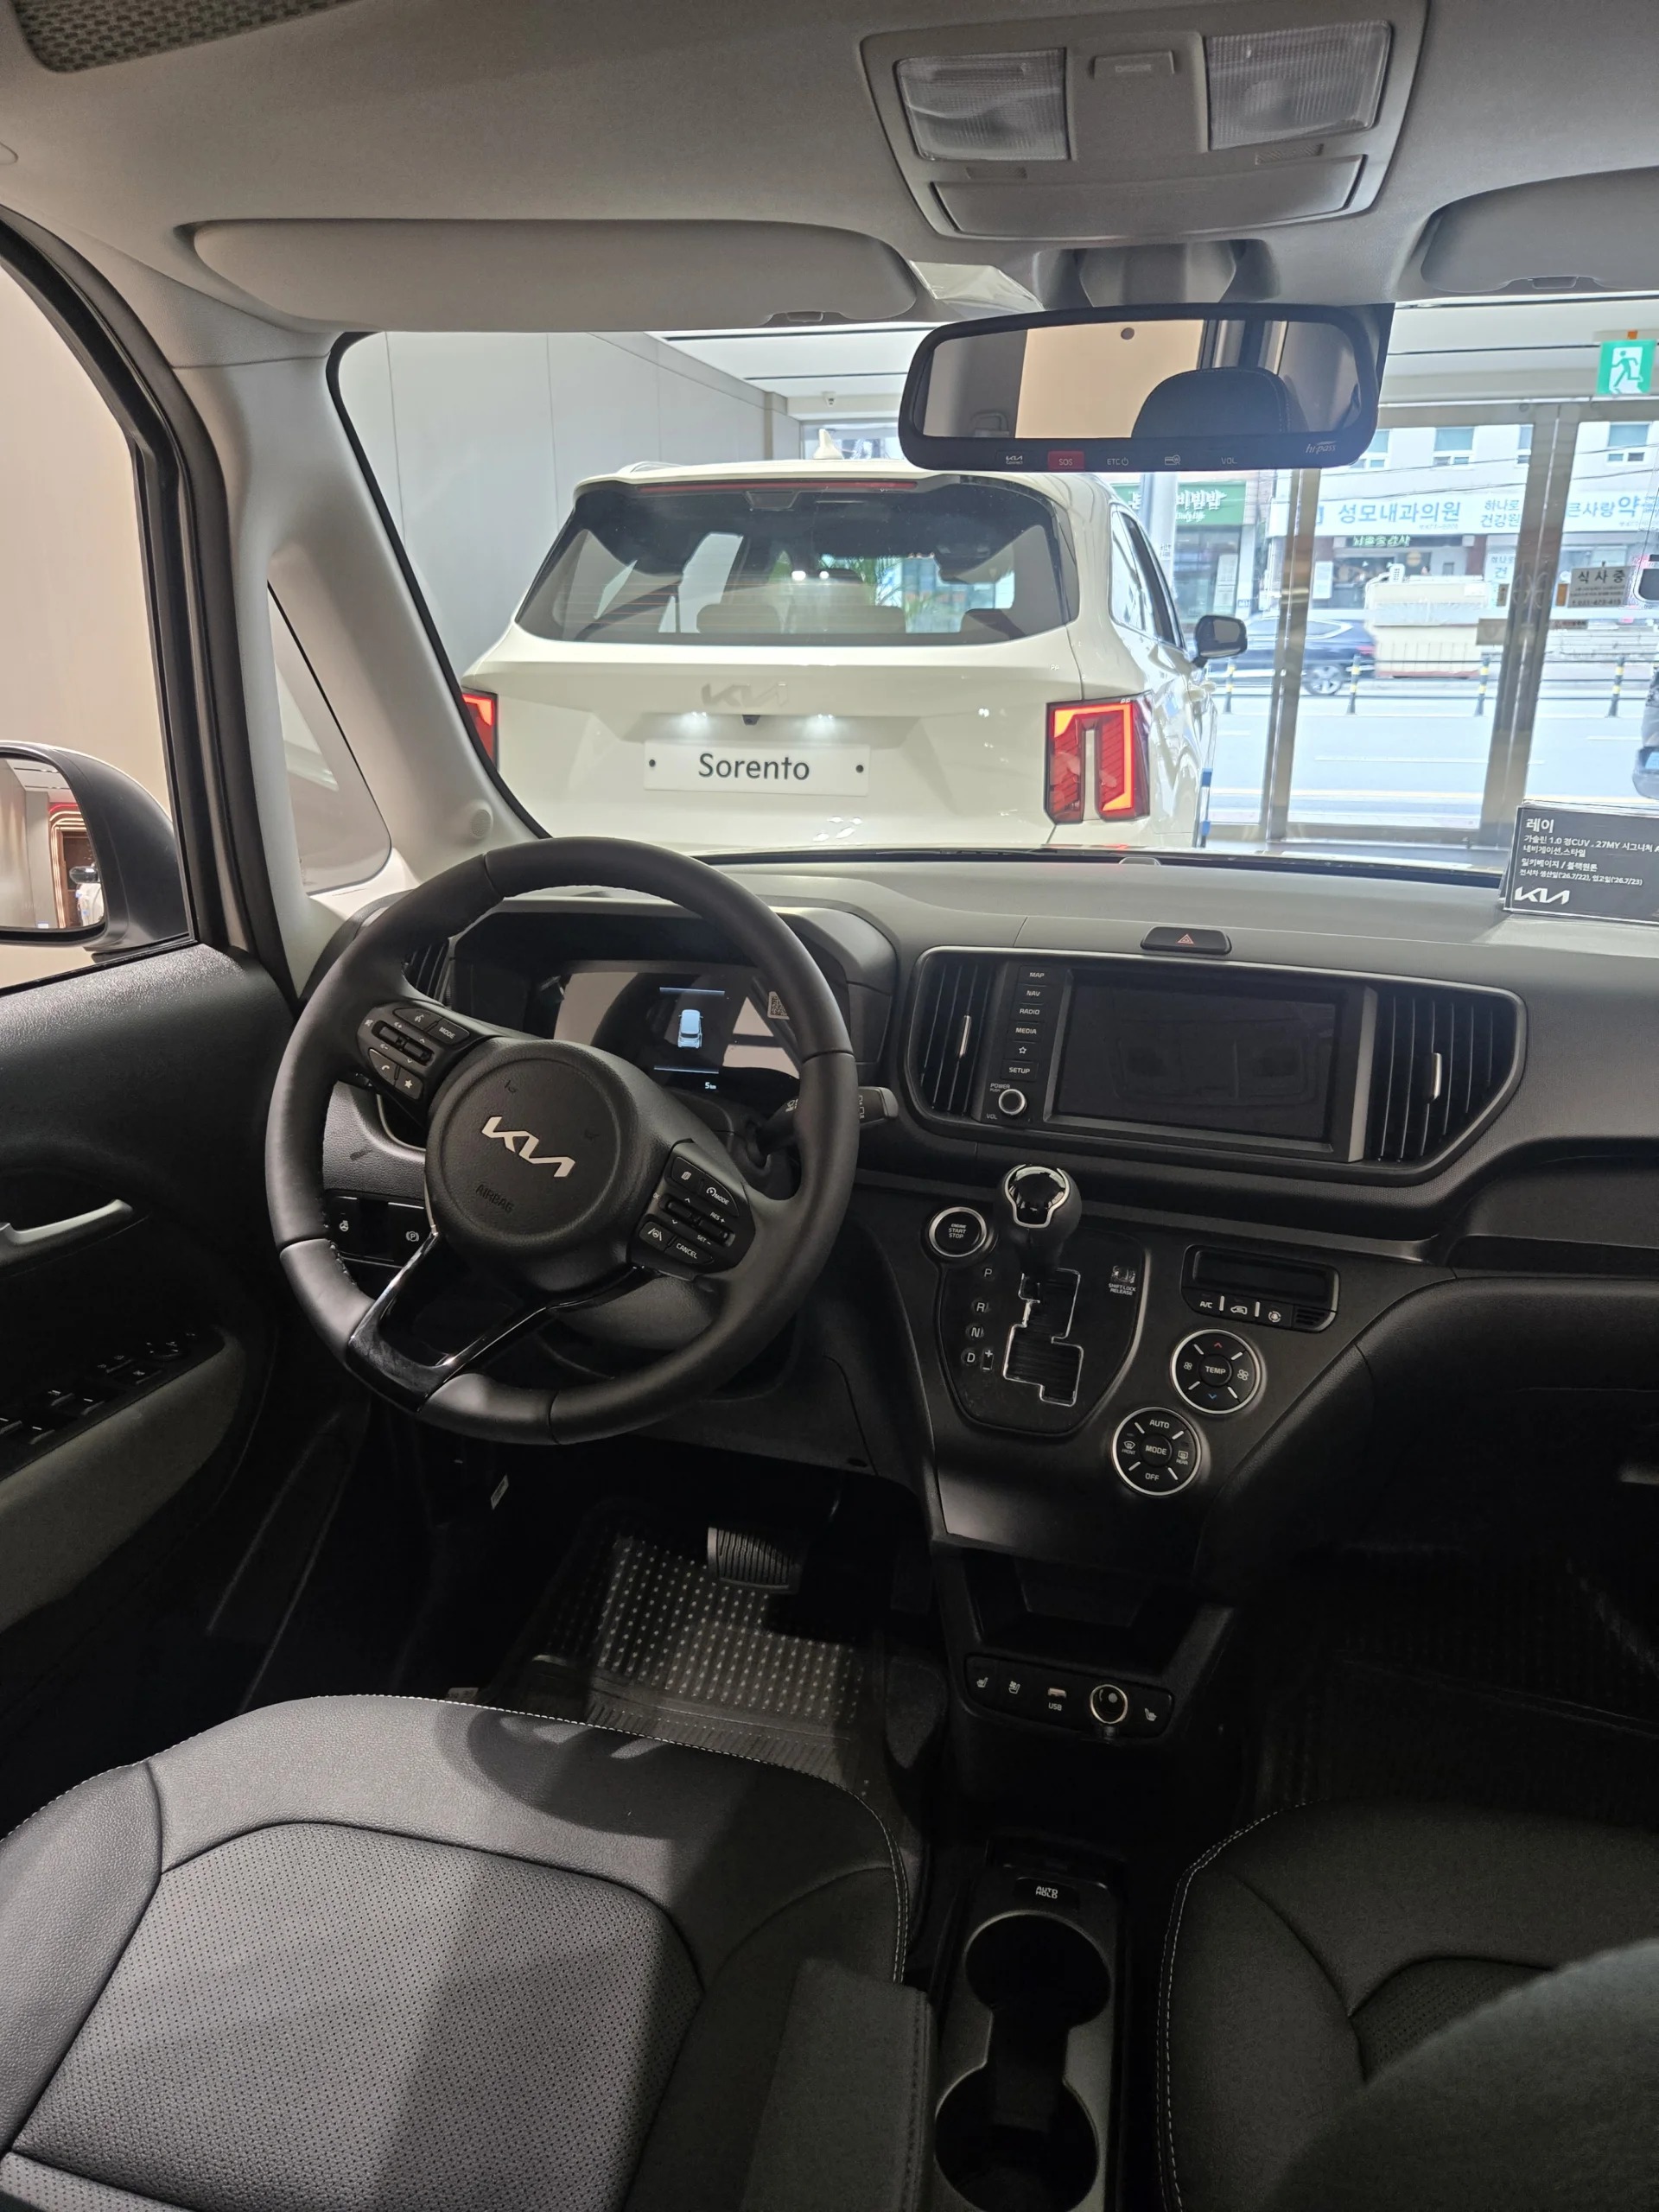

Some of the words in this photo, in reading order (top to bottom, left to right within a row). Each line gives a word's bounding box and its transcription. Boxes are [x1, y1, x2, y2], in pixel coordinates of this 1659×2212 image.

[1484, 499, 1520, 511] 하나로
[1338, 501, 1461, 524] 성모내과의원
[1481, 513, 1520, 528] 건강원
[702, 683, 789, 707] KIA
[698, 753, 810, 780] Sorento
[1526, 817, 1554, 833] 레이
[1524, 835, 1548, 844] 가솔린
[1564, 838, 1591, 847] 경CUV
[1595, 841, 1621, 849] 27MY
[1622, 842, 1653, 852] 시그니처
[1514, 887, 1570, 905] KIA
[439, 1027, 455, 1039] MODE
[481, 1116, 576, 1178] KIA
[476, 1184, 515, 1214] AIRBAG
[714, 1192, 730, 1205] MODE
[696, 1234, 707, 1243] SET
[676, 1243, 697, 1260] CANCEL
[984, 1268, 993, 1277] P
[976, 1302, 985, 1312] R
[1200, 1300, 1213, 1309] A/C
[971, 1328, 981, 1338] N
[967, 1353, 976, 1363] D
[1205, 1365, 1226, 1376] TEMP
[1149, 1419, 1170, 1429] AUTO
[1145, 1445, 1167, 1455] MODE
[1145, 1472, 1160, 1481] OFF
[1035, 1891, 1058, 1899] HOLD
[1037, 1885, 1058, 1894] AUTO
